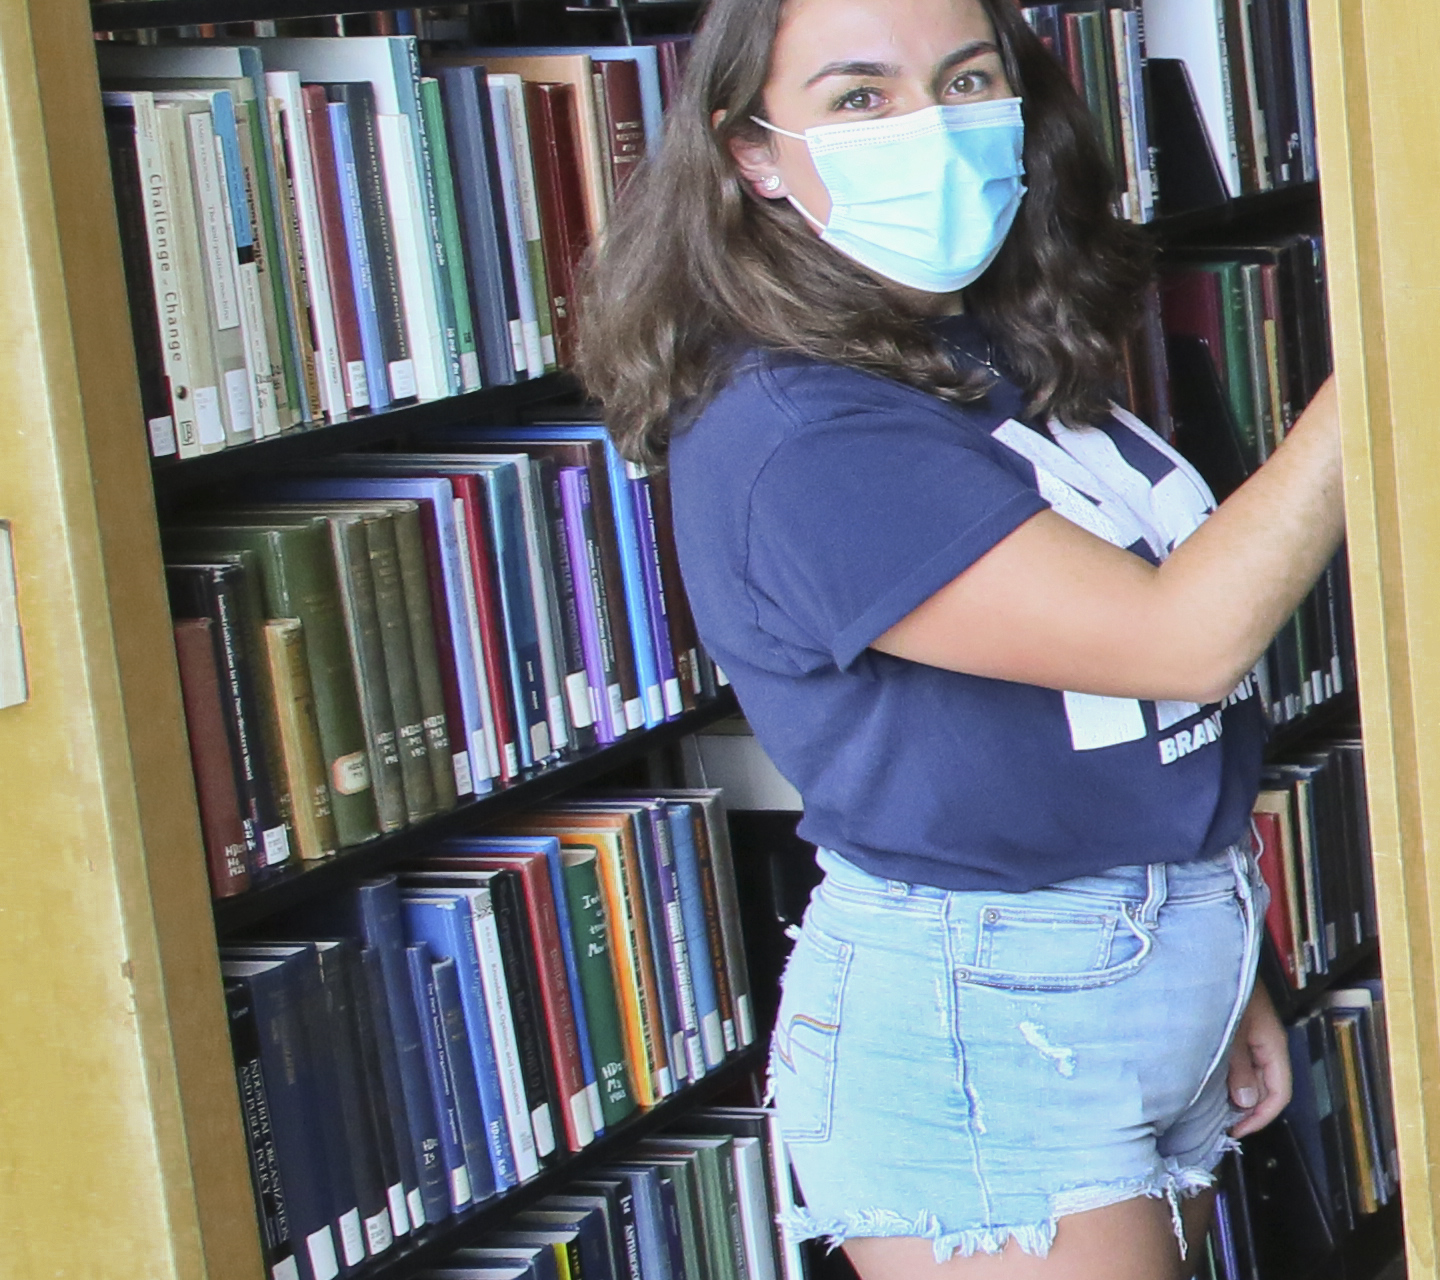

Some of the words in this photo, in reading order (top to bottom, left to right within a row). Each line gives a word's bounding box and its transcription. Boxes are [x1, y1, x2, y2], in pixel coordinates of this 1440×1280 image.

[148, 173, 172, 272] Challenge
[164, 292, 183, 362] Change
[241, 1066, 254, 1095] AND
[246, 1098, 260, 1138] PUBLIC
[249, 1058, 270, 1135] INDUSTRIAL
[265, 1141, 290, 1242] ORGANIZATION
[255, 1148, 271, 1195] POLICY
